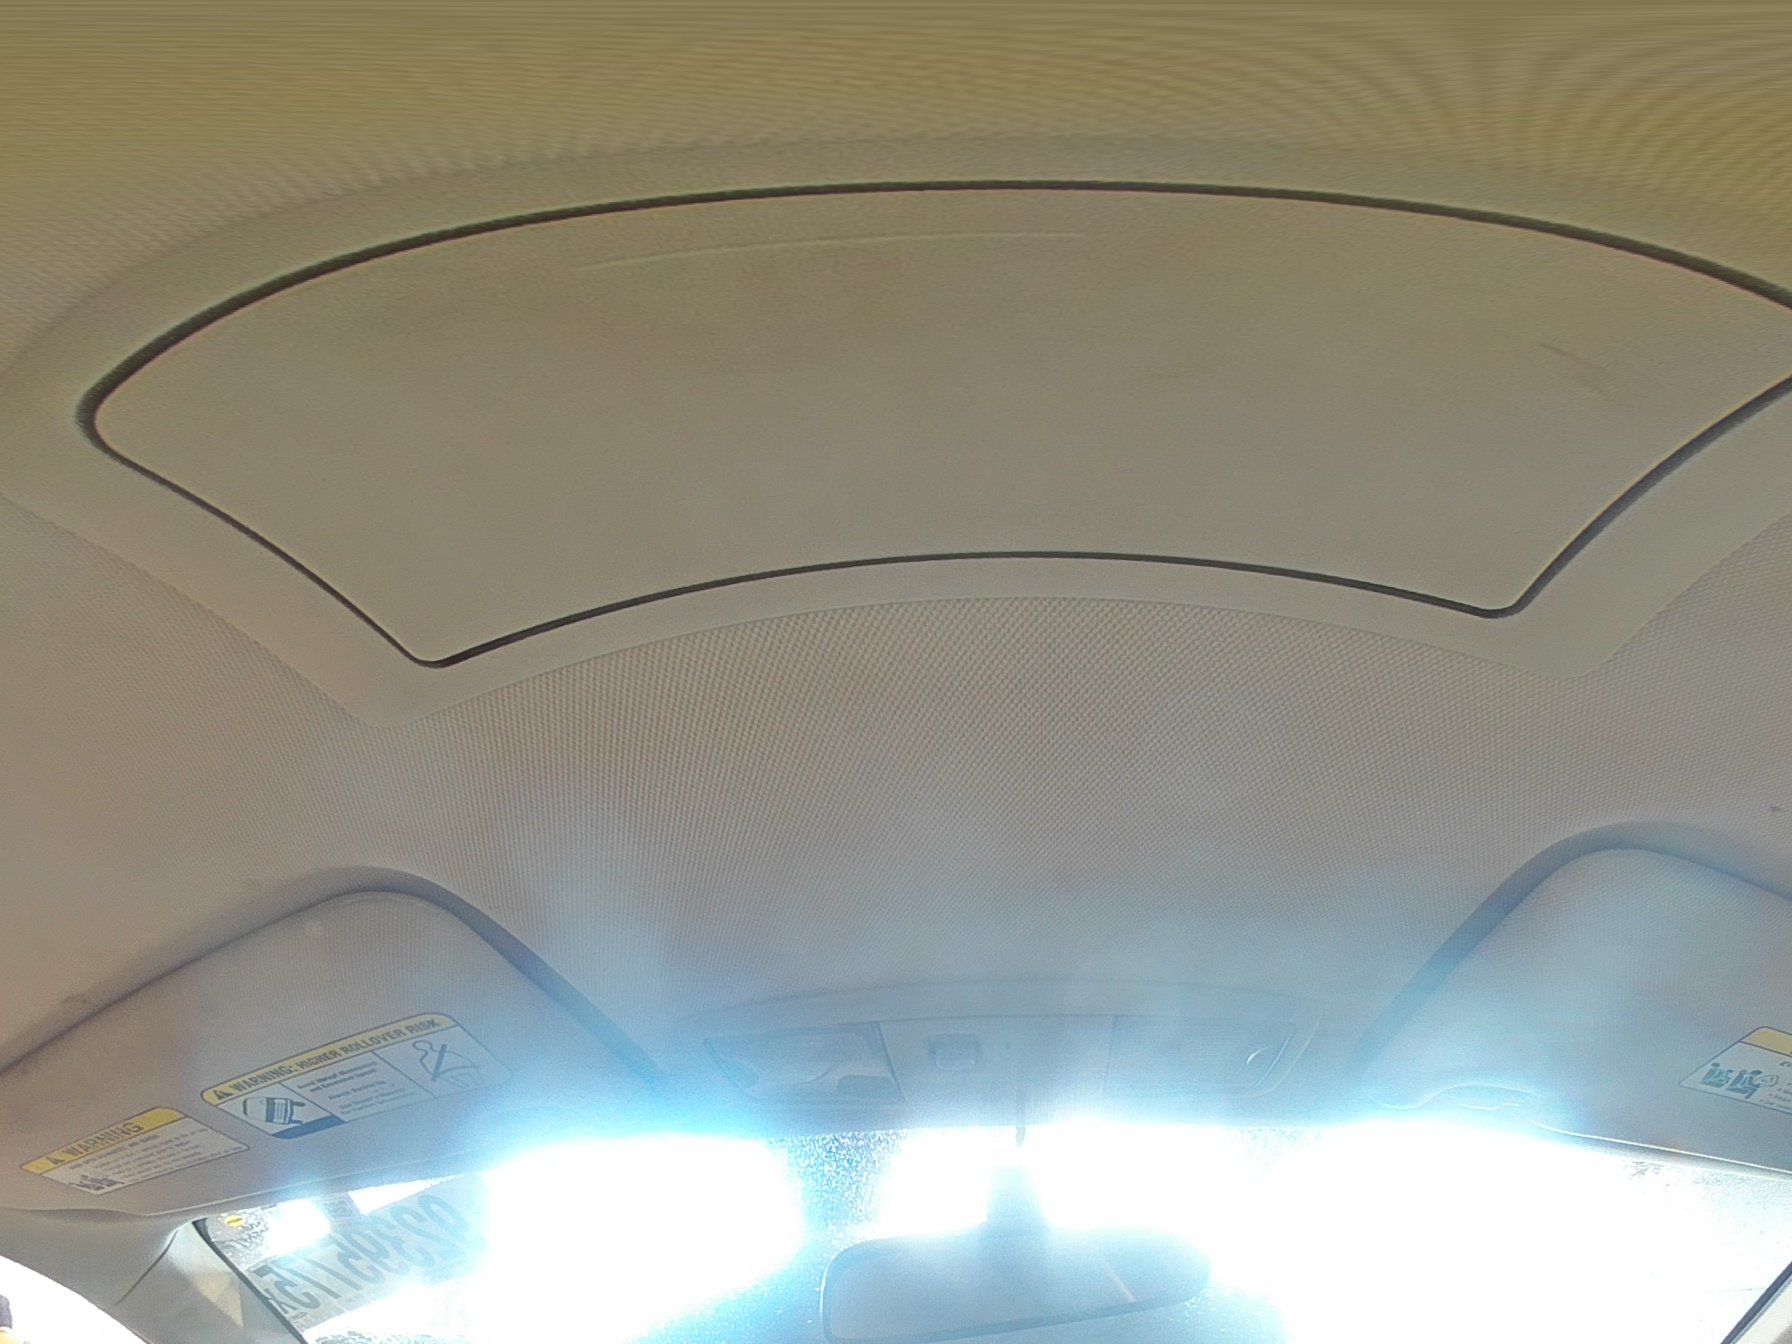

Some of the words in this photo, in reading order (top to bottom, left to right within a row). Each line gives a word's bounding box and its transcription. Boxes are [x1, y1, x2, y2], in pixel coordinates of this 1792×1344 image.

[229, 1064, 298, 1093] WARNING:
[296, 1049, 342, 1070] HIGHER
[340, 1027, 406, 1056] ROLLOVER
[405, 1018, 441, 1034] RISK
[62, 1122, 144, 1157] WARNING
